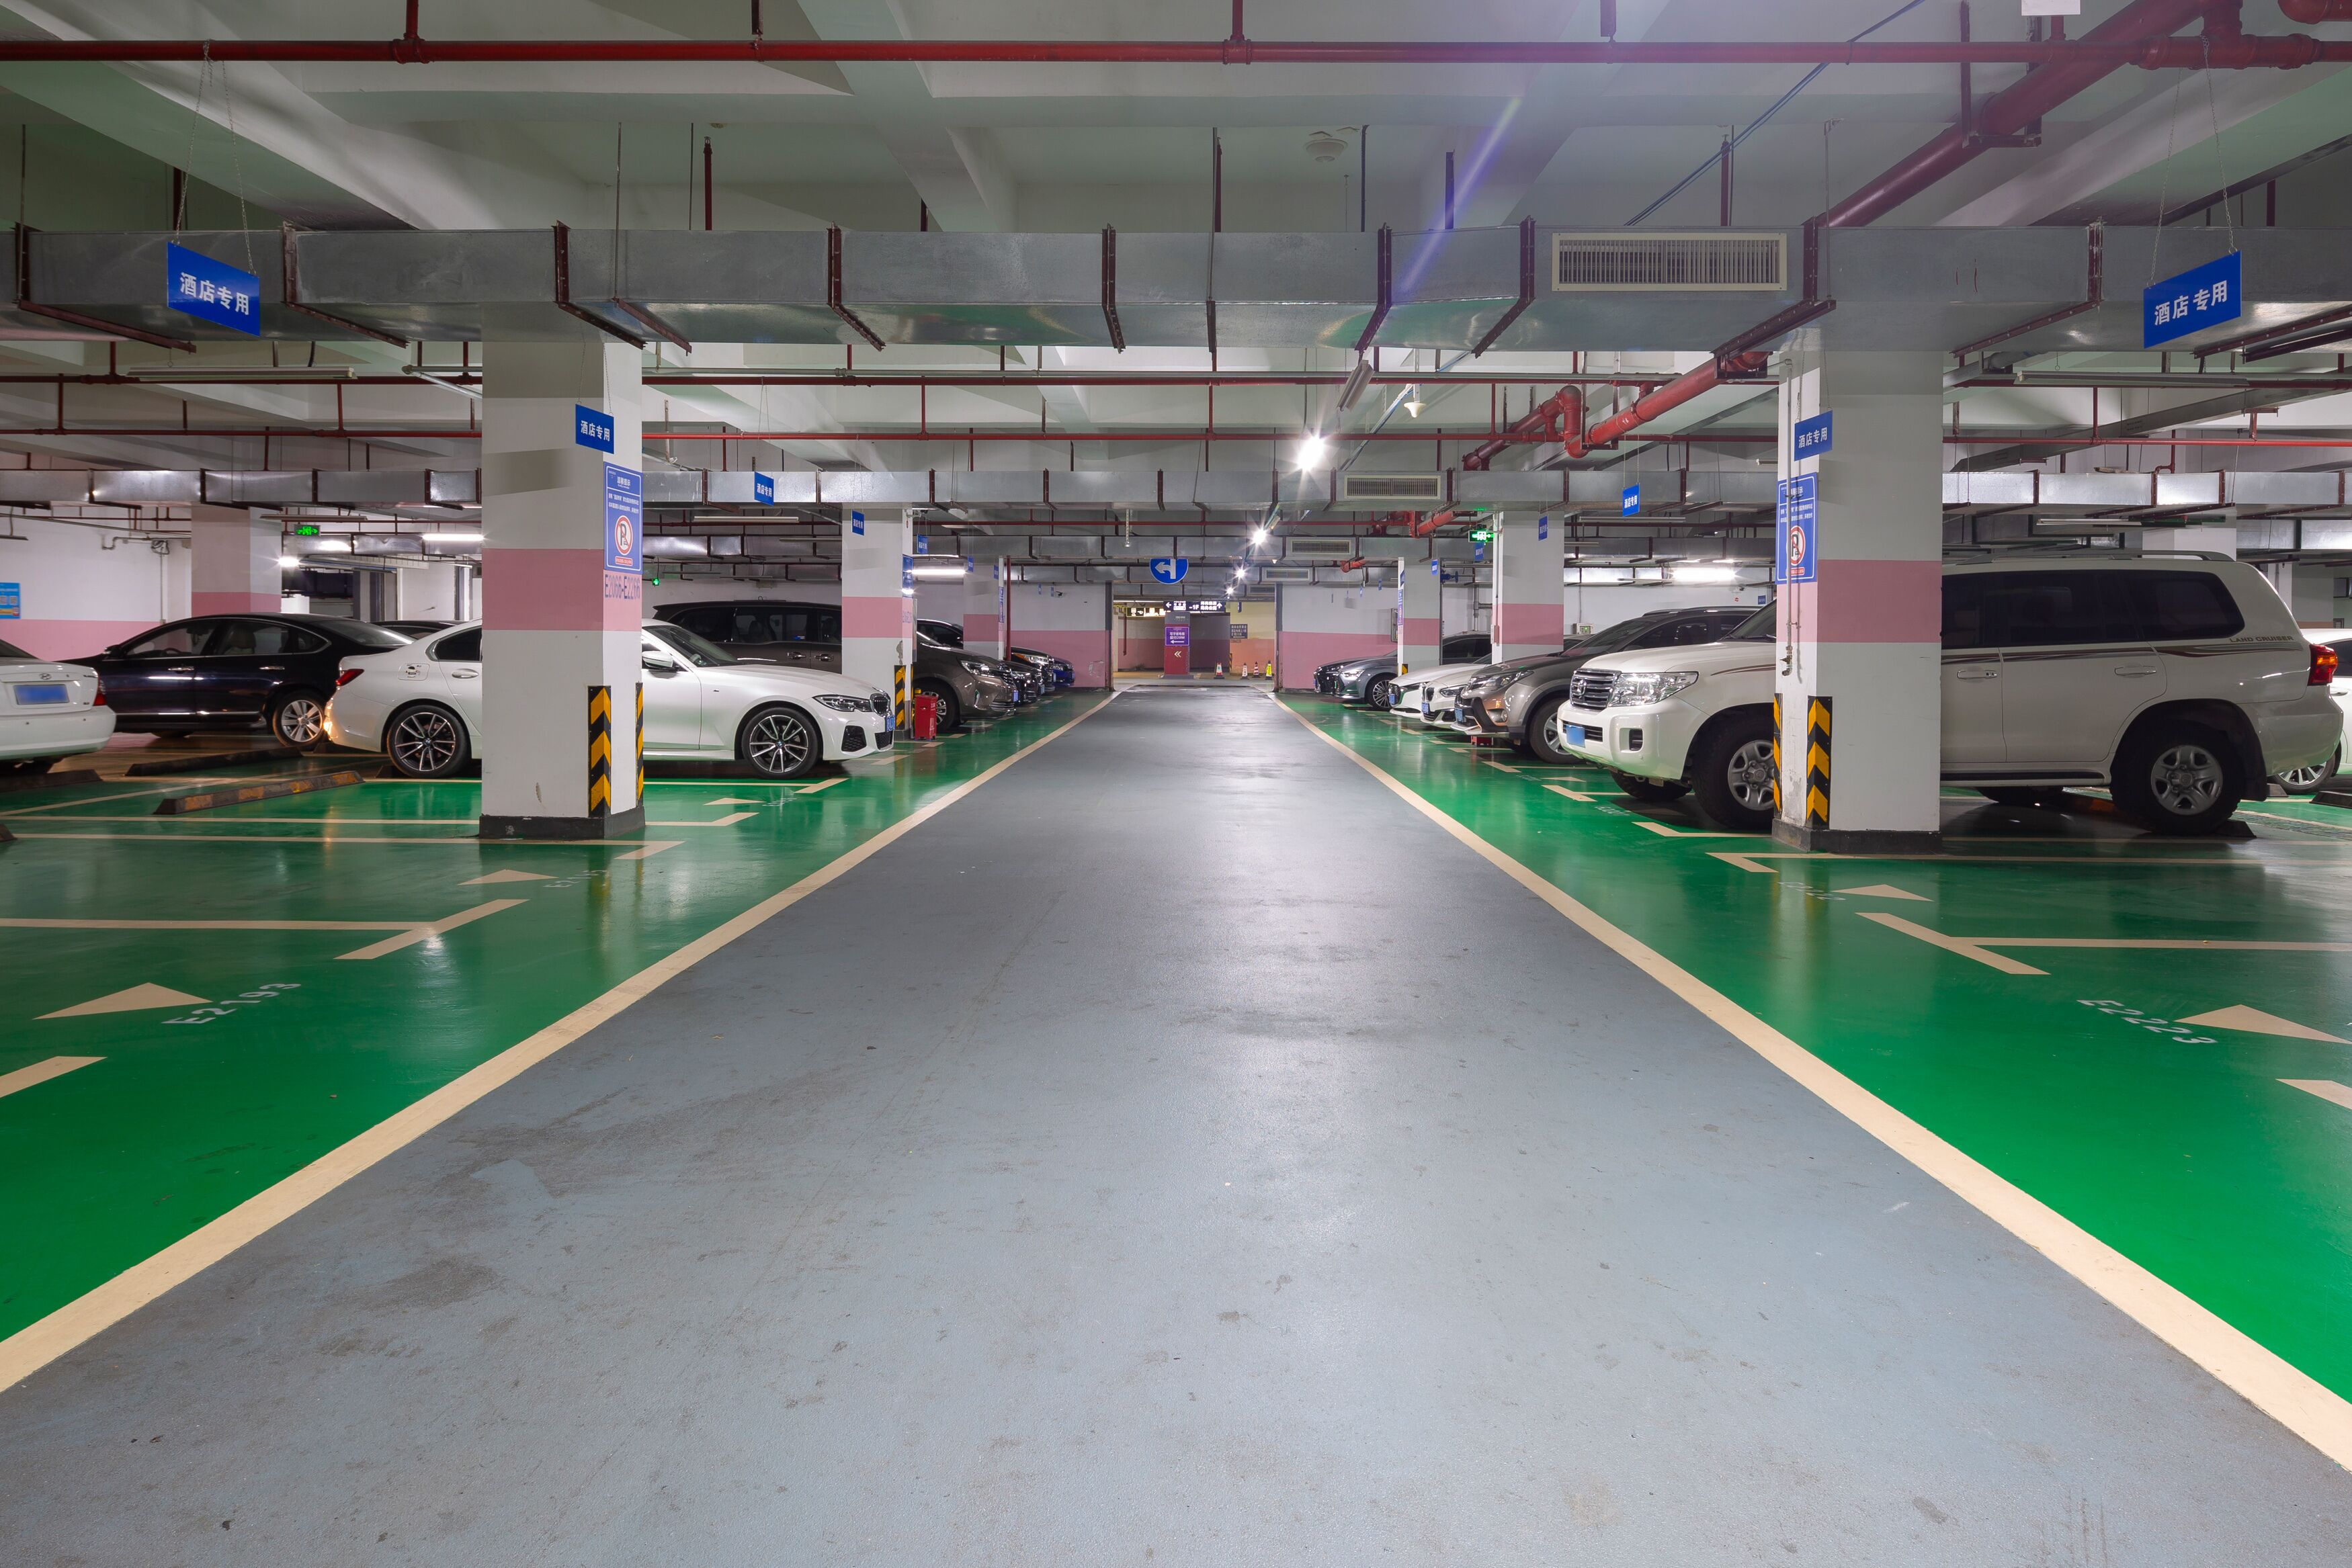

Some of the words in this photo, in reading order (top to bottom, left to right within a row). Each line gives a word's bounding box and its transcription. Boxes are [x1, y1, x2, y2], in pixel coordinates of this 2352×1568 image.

[179, 271, 249, 316] 酒店专用
[2154, 279, 2228, 326] 酒店专用
[580, 420, 610, 441] 酒店专用
[1798, 427, 1828, 449] 酒店专用
[757, 483, 772, 497] 酒店专用
[1624, 495, 1638, 509] 酒店专用
[161, 983, 302, 1024] E2193
[2076, 1000, 2219, 1044] E2223
